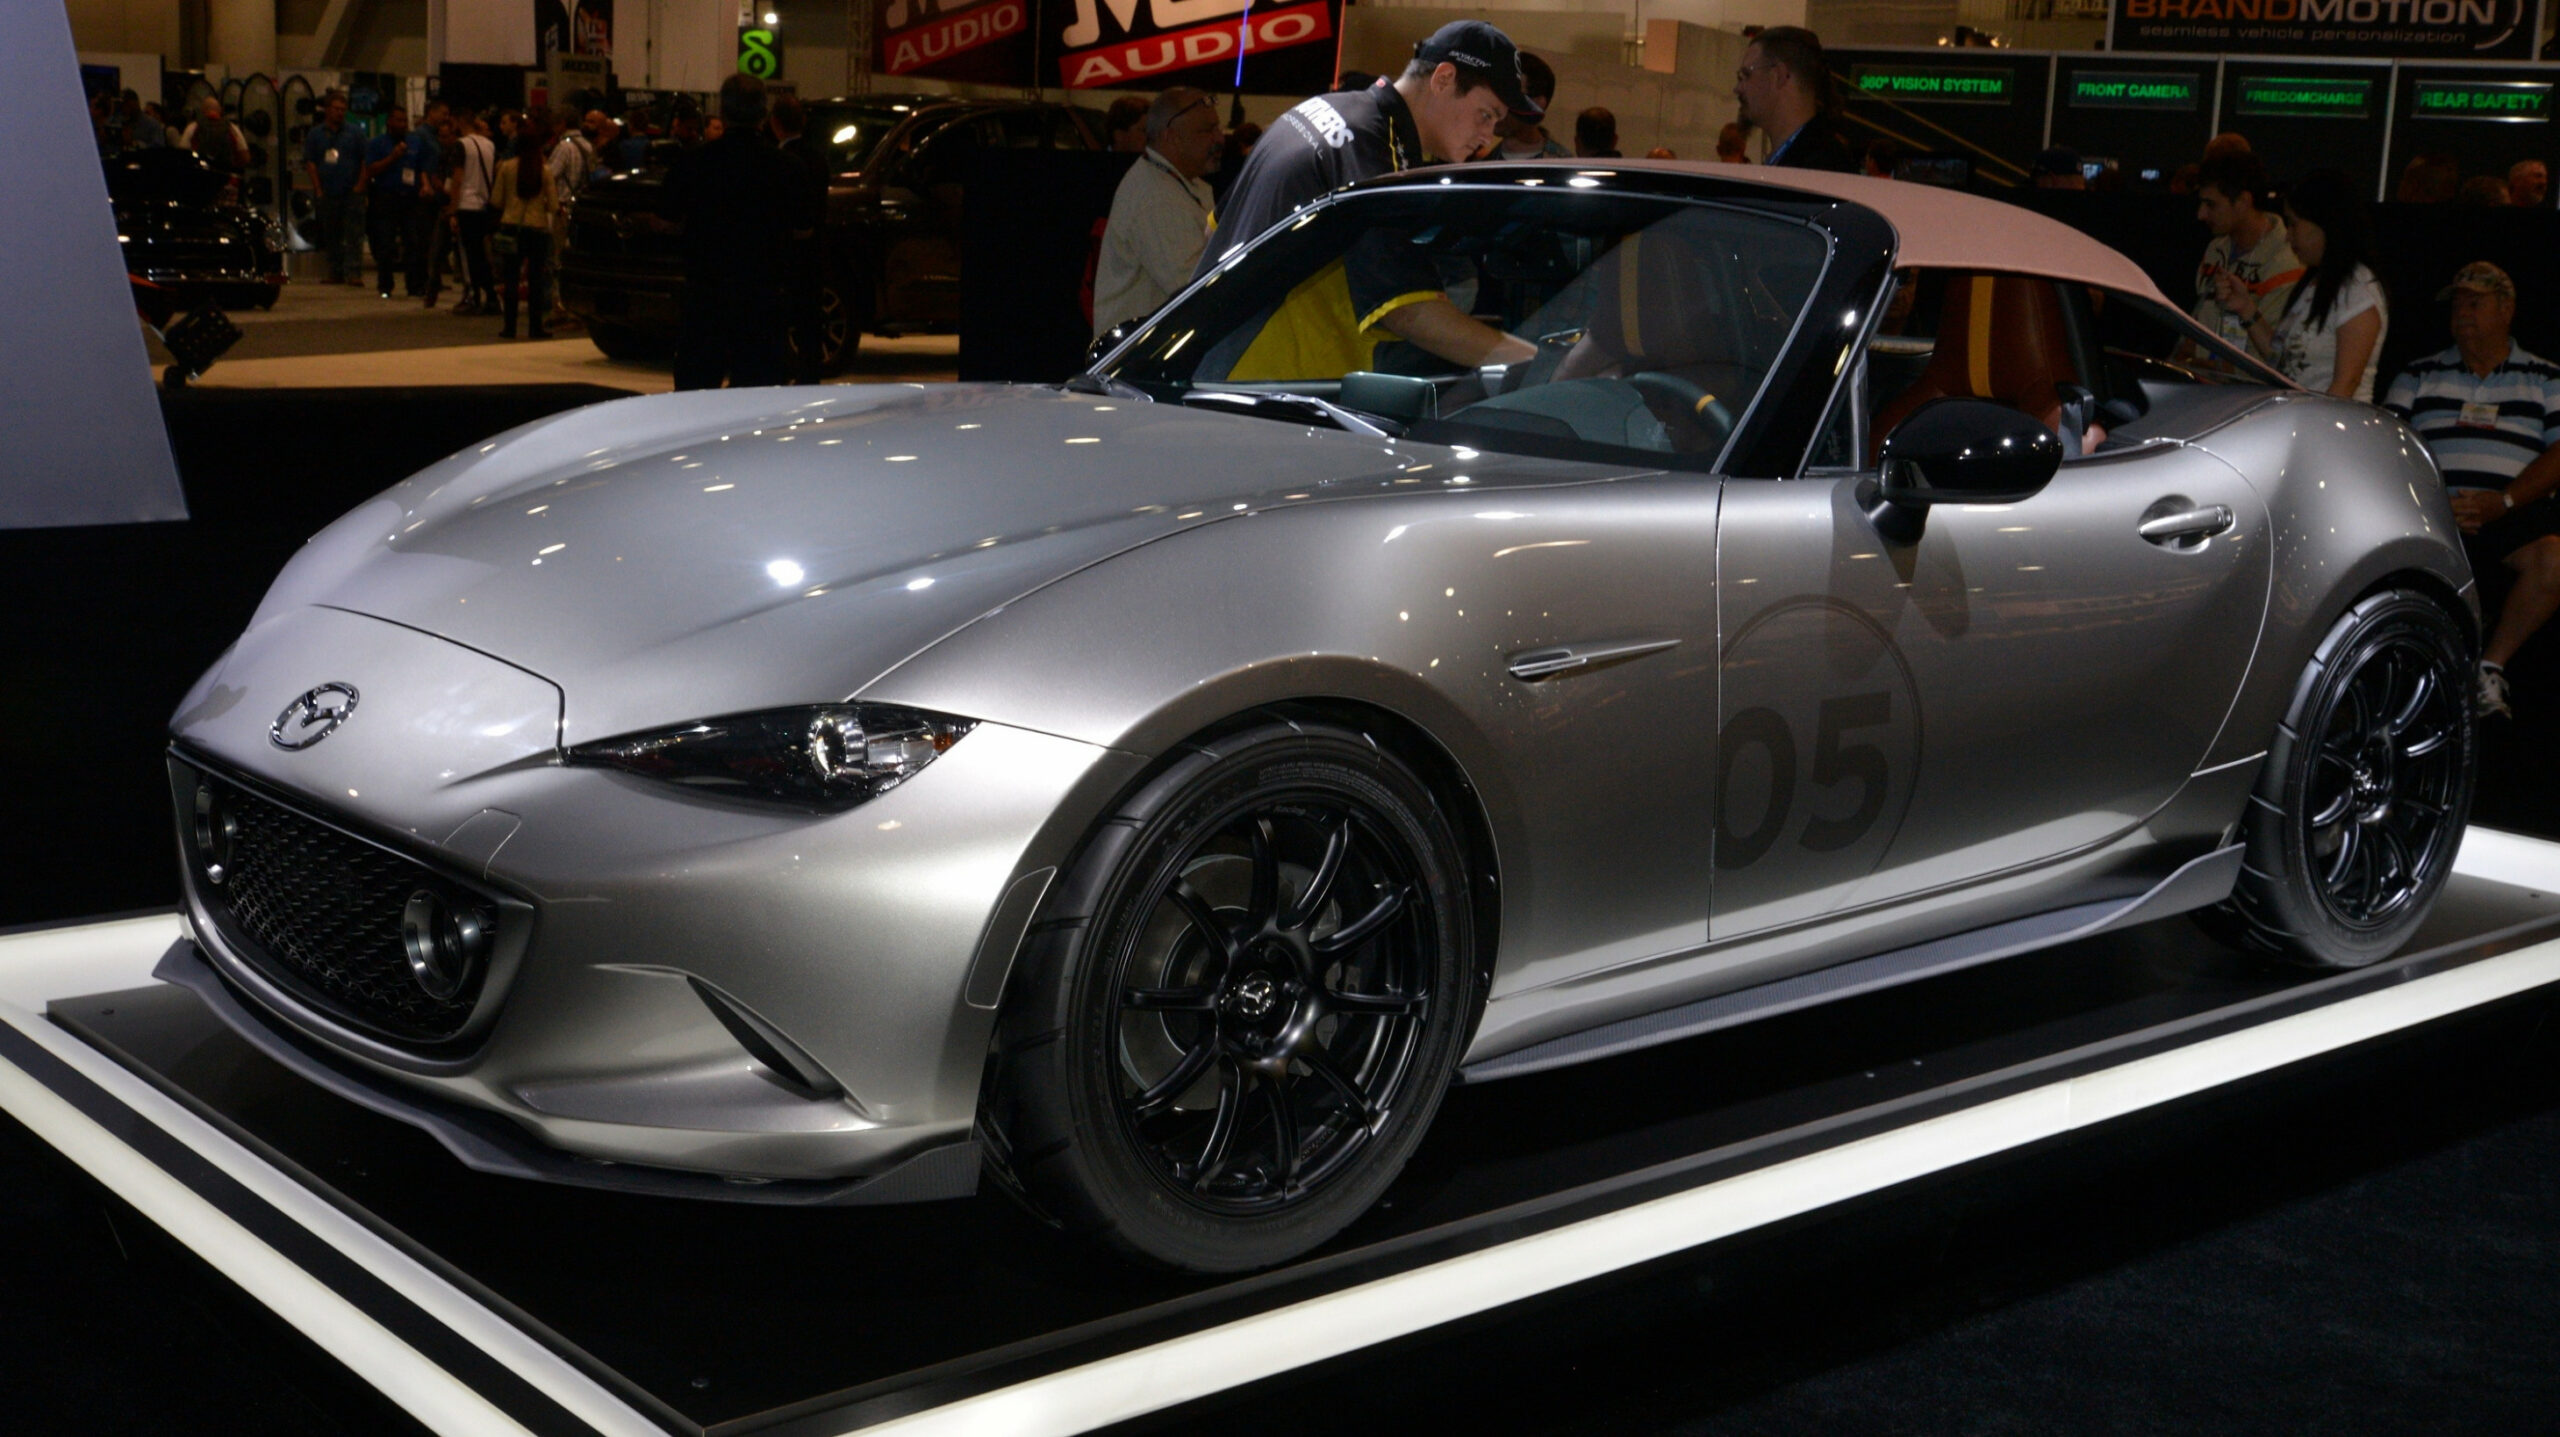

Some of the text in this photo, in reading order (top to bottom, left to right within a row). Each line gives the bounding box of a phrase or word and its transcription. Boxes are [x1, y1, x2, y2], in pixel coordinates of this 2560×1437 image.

[890, 3, 1021, 72] AUDIO
[2139, 24, 2467, 44] seamless vehicle personalization
[1071, 13, 1317, 87] AUDIO
[1891, 76, 1941, 91] VISION
[1942, 77, 2003, 93] SYSTEM
[2076, 82, 2191, 99] FRONT CAMERA
[2420, 90, 2545, 111] REAR SAFETY
[1713, 691, 1892, 870] 05
